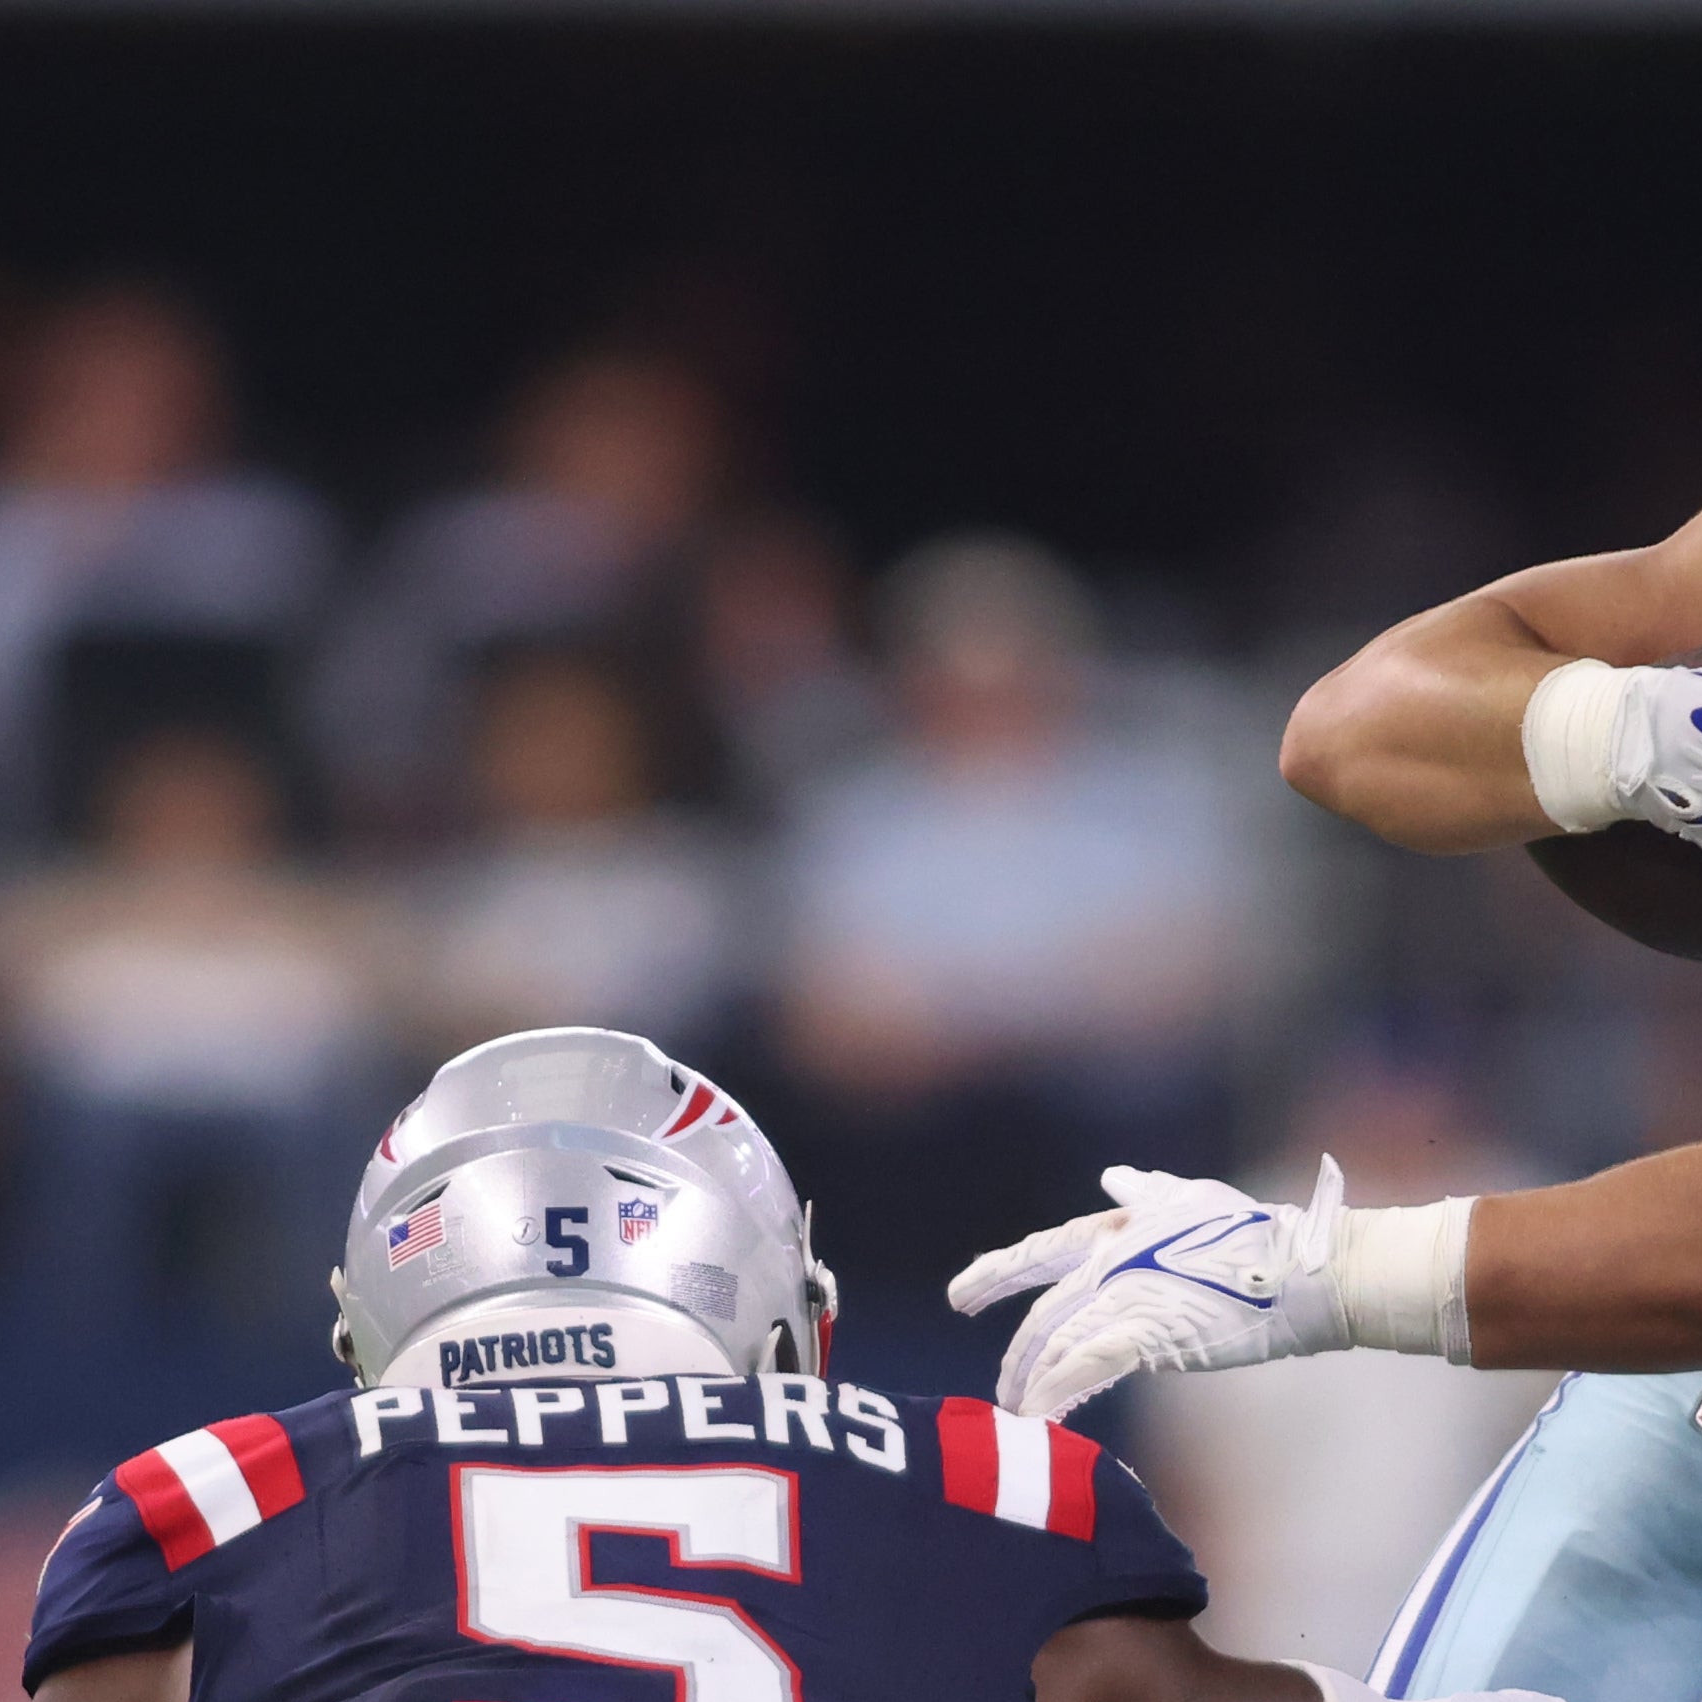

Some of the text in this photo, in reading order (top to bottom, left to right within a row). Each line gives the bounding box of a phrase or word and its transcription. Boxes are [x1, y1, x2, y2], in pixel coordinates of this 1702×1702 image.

[545, 1207, 589, 1277] 5
[439, 1322, 616, 1387] PATRIOTS
[351, 1373, 907, 1473] PEPPERS
